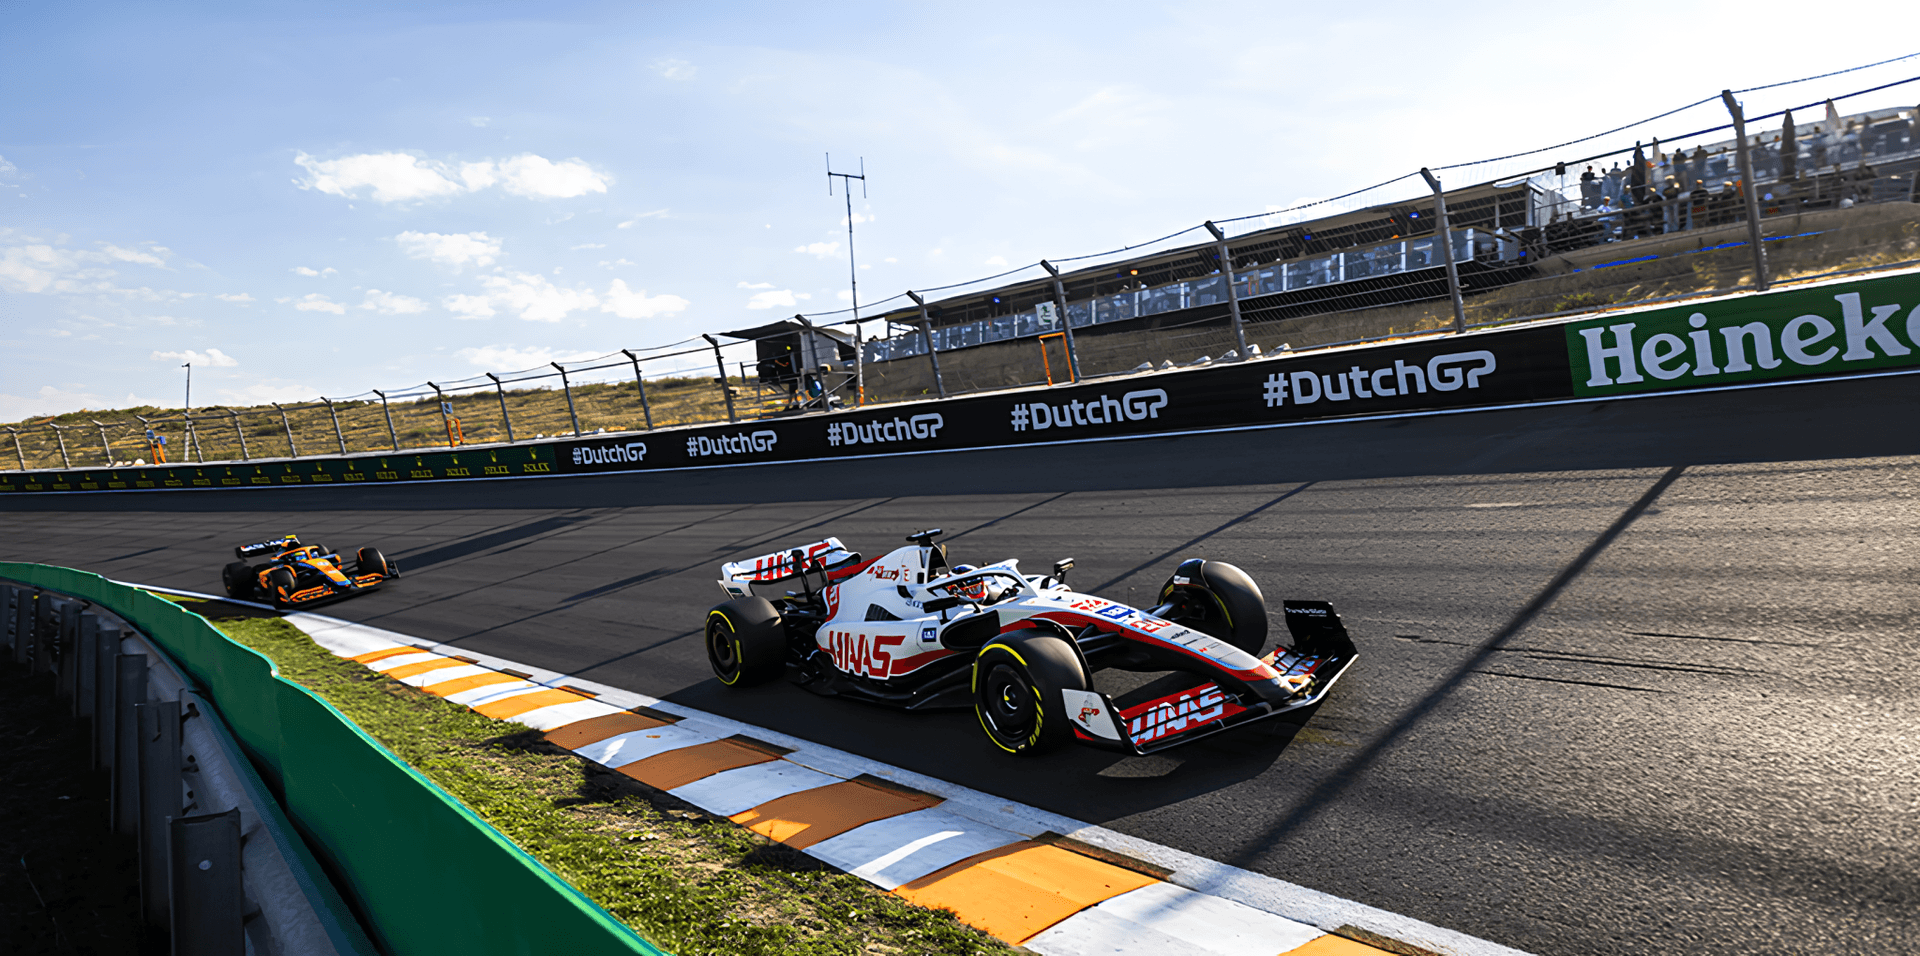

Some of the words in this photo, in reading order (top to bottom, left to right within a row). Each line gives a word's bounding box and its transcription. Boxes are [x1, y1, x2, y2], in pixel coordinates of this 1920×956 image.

[1579, 292, 1920, 387] Heinek
[1263, 349, 1497, 407] #DutchGP
[827, 412, 944, 447] #DutchGP
[1010, 388, 1168, 432] #DutchGP
[572, 442, 647, 465] #DutchGP
[686, 429, 778, 457] #DutchGP
[829, 630, 906, 678] HAAS
